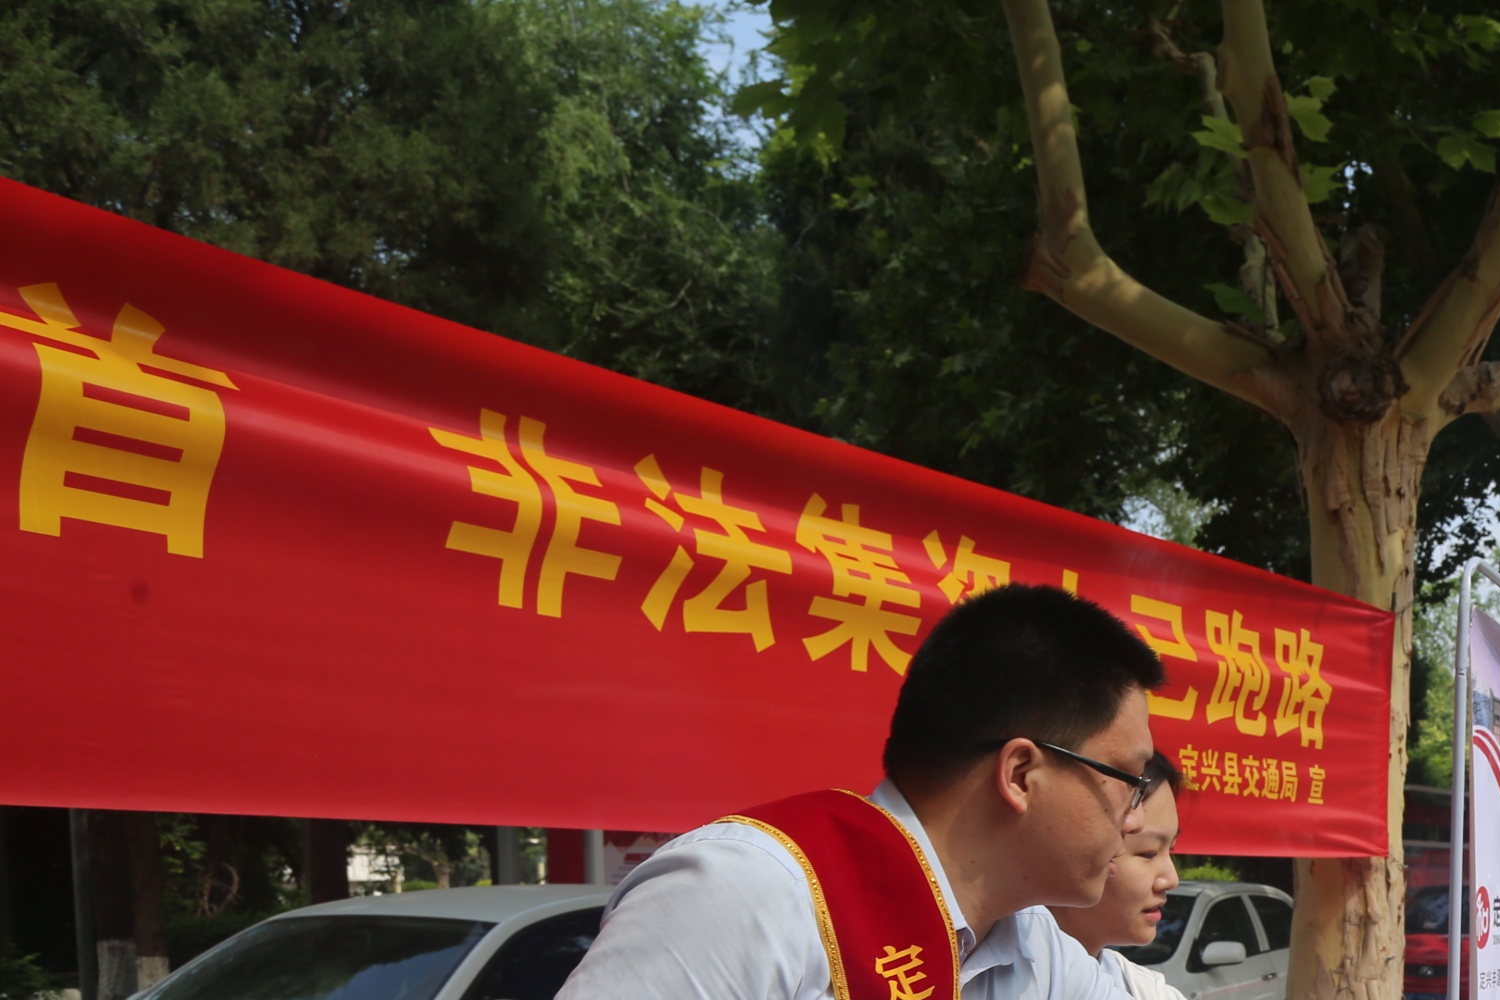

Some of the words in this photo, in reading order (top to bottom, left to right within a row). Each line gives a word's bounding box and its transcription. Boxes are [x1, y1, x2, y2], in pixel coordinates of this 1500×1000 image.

[0, 282, 240, 559] 首
[428, 407, 1333, 750] 非法集已跑路
[1178, 744, 1298, 802] 定兴县交通局
[1308, 764, 1327, 805] 宣
